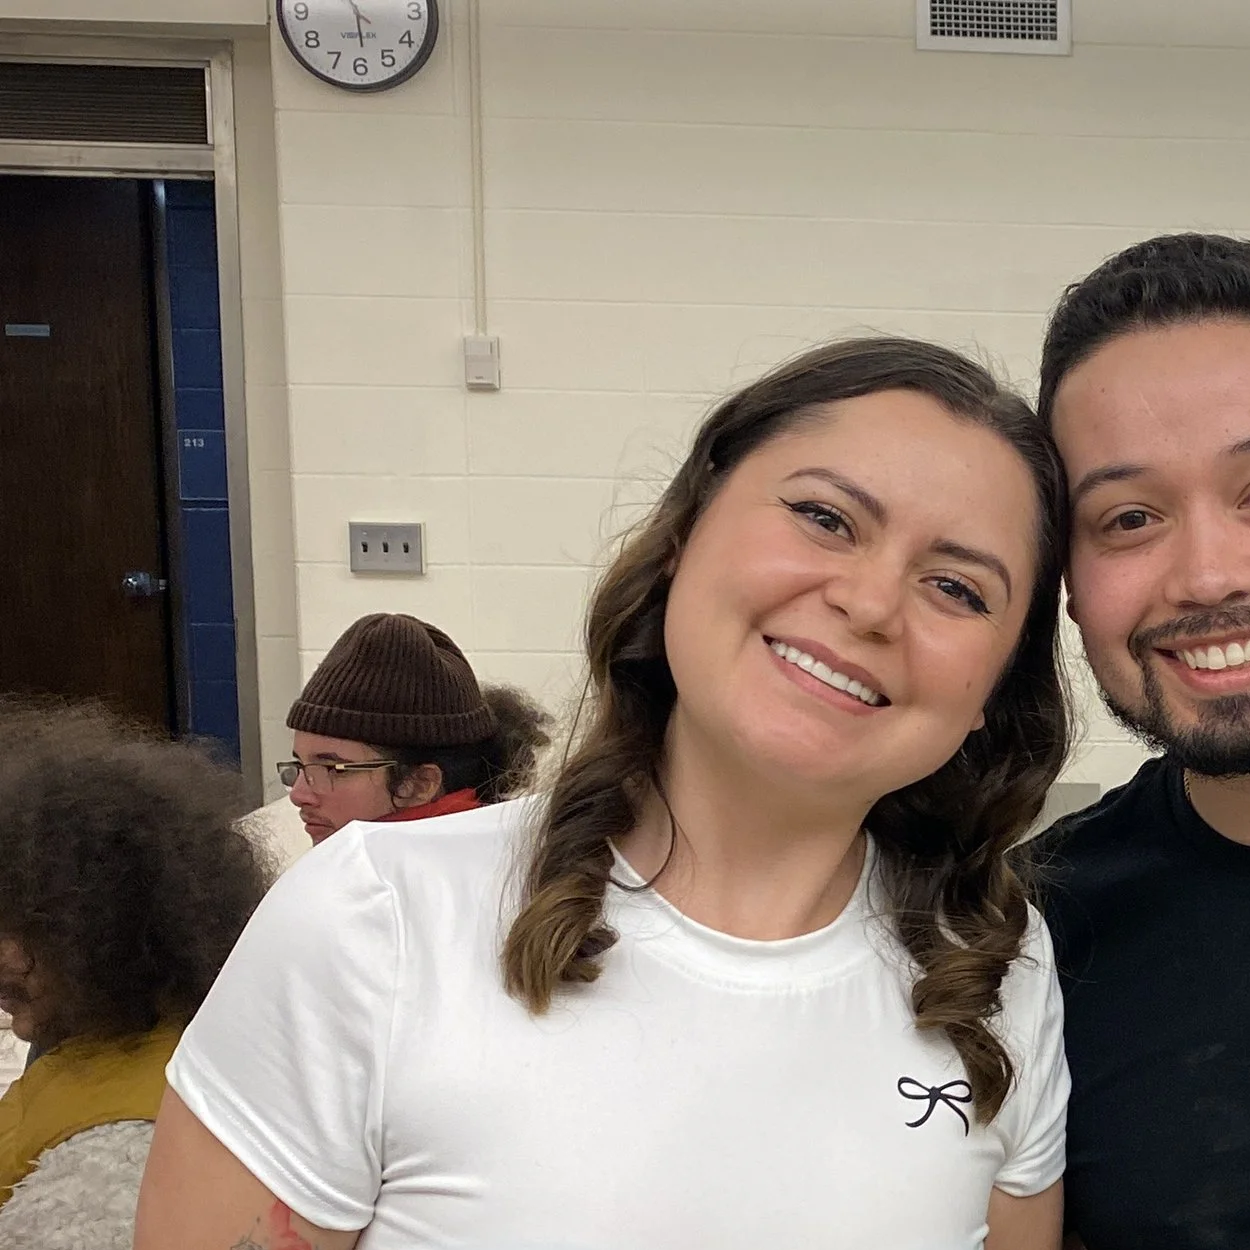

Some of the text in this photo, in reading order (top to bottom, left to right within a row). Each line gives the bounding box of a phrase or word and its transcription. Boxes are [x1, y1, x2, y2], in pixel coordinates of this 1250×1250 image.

[294, 2, 309, 21] 9
[407, 2, 422, 20] 3
[305, 30, 320, 48] 8
[398, 29, 415, 48] 4
[327, 51, 342, 69] 7
[352, 57, 368, 76] 6
[381, 49, 396, 67] 5
